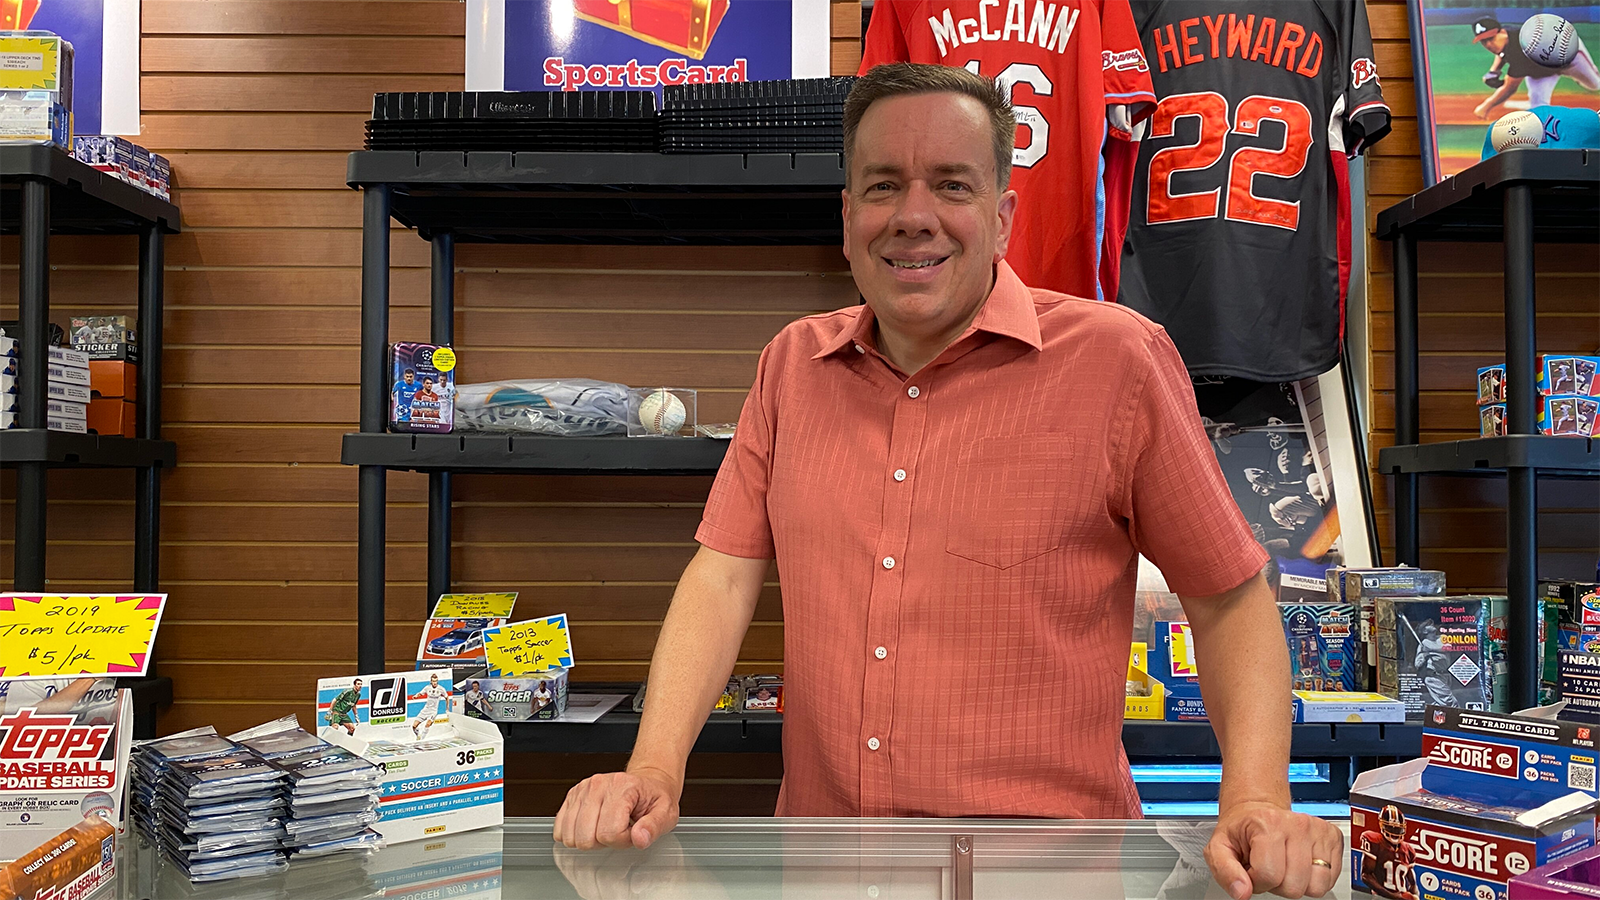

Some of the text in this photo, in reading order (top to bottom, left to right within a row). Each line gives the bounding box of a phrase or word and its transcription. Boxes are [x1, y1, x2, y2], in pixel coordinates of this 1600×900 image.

[928, 0, 1080, 58] McCANN
[1153, 13, 1324, 79] HEYWARD
[543, 57, 748, 92] SportsCard
[1147, 91, 1314, 231] 22
[75, 343, 118, 352] STICKER
[1290, 576, 1318, 585] MEMORABLE
[45, 605, 100, 617] 2019
[65, 621, 131, 635] UPDATE
[509, 628, 537, 640] 2013
[497, 638, 554, 655] Topps Soccer
[1441, 634, 1477, 645] CONLON
[488, 690, 532, 703] SOCCER
[1573, 698, 1600, 708] AUTOGRAP
[372, 707, 404, 716] DONRUSS
[1462, 717, 1556, 736] NFL TRADING CARDS
[0, 709, 111, 760] topps
[456, 750, 476, 766] 36
[476, 749, 494, 757] PACKS
[1428, 741, 1510, 769] SCORE 12
[1540, 753, 1556, 761] CARDS
[387, 761, 408, 770] CARDS
[0, 775, 110, 789] PDATE SERIES
[400, 773, 470, 792] SOCCER 2016
[396, 806, 417, 814] DELIVERS
[424, 802, 439, 810] INSERT
[1360, 838, 1371, 852] 10
[1409, 829, 1526, 875] SCORE 12
[23, 858, 45, 875] COLLECT
[43, 853, 54, 863] ALL
[1383, 860, 1408, 892] 10
[68, 867, 101, 900] BASEBALL
[1441, 878, 1462, 889] CARDS
[1441, 886, 1471, 898] PER PACK
[1478, 890, 1493, 900] 36
